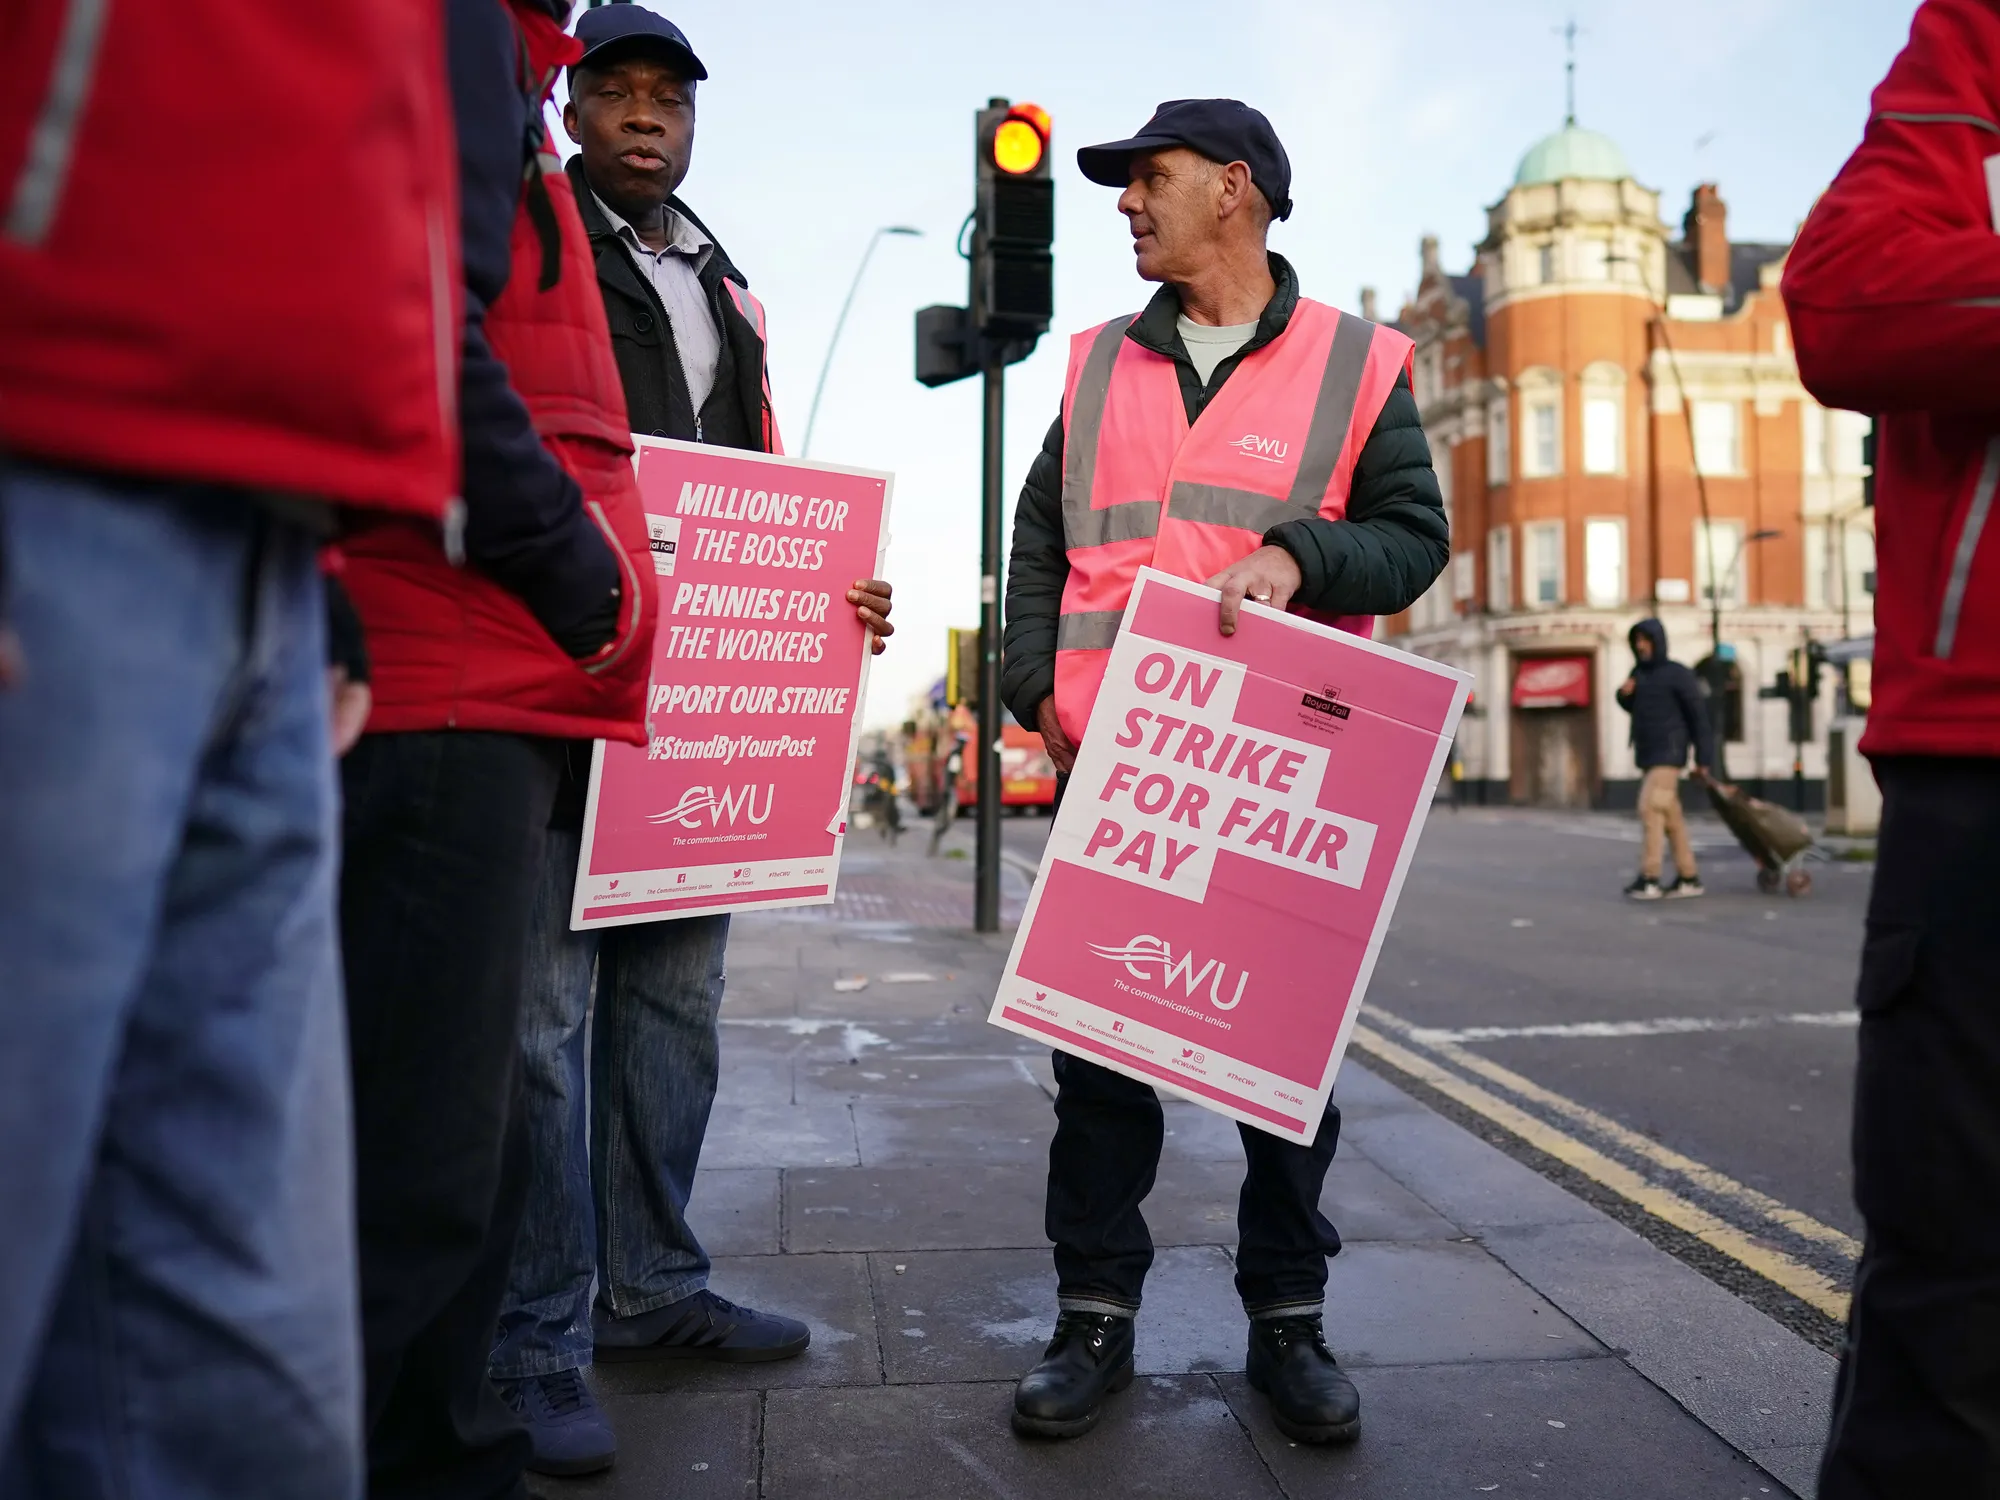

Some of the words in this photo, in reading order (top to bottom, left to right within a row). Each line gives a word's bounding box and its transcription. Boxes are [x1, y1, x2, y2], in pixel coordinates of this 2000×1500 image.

[1240, 434, 1288, 458] CWU
[675, 481, 803, 528] MILLIONS
[803, 498, 849, 532] FOR
[660, 543, 674, 552] Fail
[692, 527, 740, 564] THE
[739, 532, 827, 571] BOSSES
[671, 582, 784, 621] PENNIES
[784, 589, 830, 623] FOR
[666, 625, 715, 659] THE
[716, 628, 827, 663] WORKERS
[1134, 651, 1223, 709] ON
[648, 684, 731, 714] PPORT
[730, 685, 781, 715] OUR
[775, 687, 850, 715] STRIKE
[1305, 696, 1331, 710] Royal
[1331, 705, 1348, 717] Fail
[648, 734, 816, 765] #StandByYourPost
[1114, 706, 1308, 795] STRIKE
[678, 784, 774, 829] CWU
[1098, 761, 1211, 830] FOR
[1217, 796, 1349, 872] FAIR
[672, 837, 686, 846] The
[686, 834, 746, 846] communications
[747, 832, 768, 841] union
[1083, 816, 1200, 882] PAY
[593, 891, 632, 901] @DaveWardGS
[656, 885, 698, 894] Communications
[726, 880, 754, 888] @CWUNews
[1123, 934, 1250, 1011] CWU
[1016, 997, 1059, 1018] @DaveWardGS
[1113, 978, 1129, 992] The
[1130, 986, 1205, 1021] communications
[1205, 1014, 1232, 1031] union
[1075, 1019, 1087, 1029] The
[1087, 1024, 1136, 1049] Communications
[1136, 1043, 1155, 1055] Union
[1171, 1057, 1208, 1076] @CWUNews
[1226, 1072, 1257, 1088] #TheCWU
[1273, 1090, 1304, 1106] CWU.ORG
